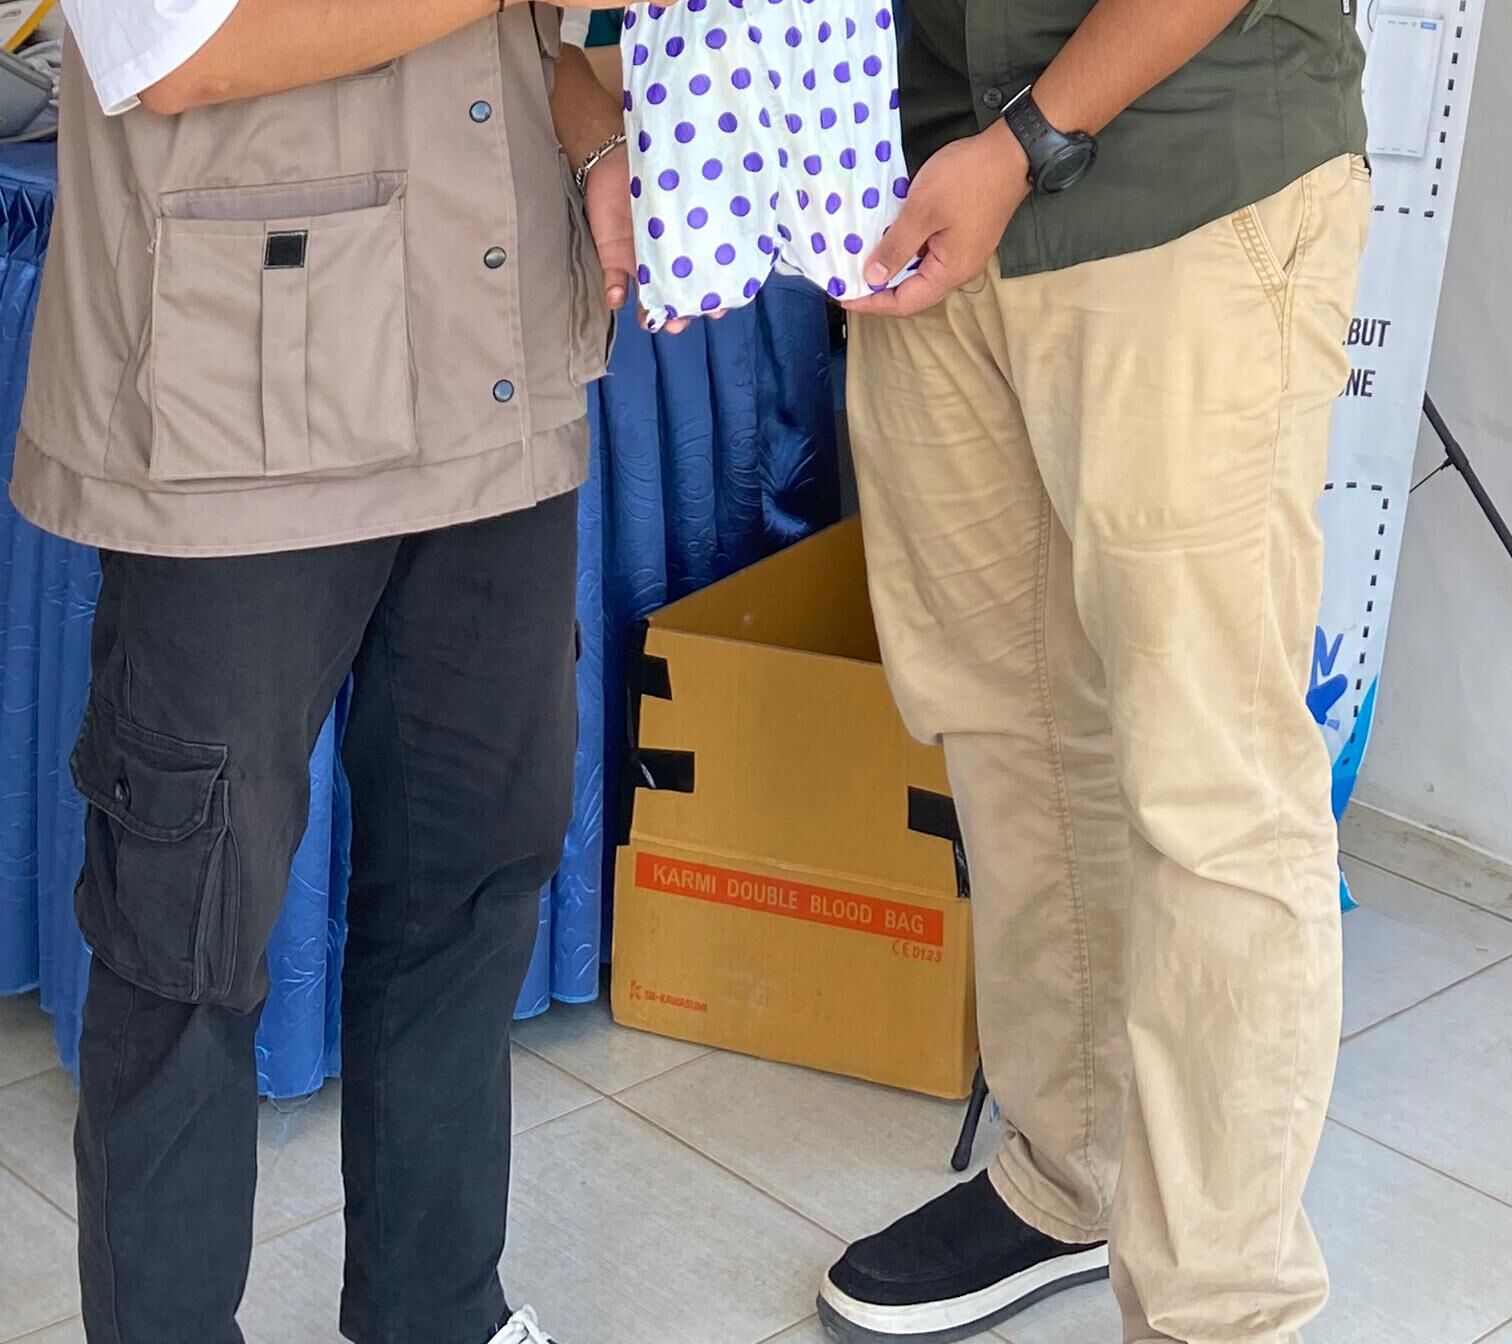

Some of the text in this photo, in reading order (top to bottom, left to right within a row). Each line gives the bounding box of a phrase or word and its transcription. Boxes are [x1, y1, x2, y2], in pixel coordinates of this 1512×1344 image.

[653, 864, 924, 935] KARMI DOUBLE BLOOD BAG
